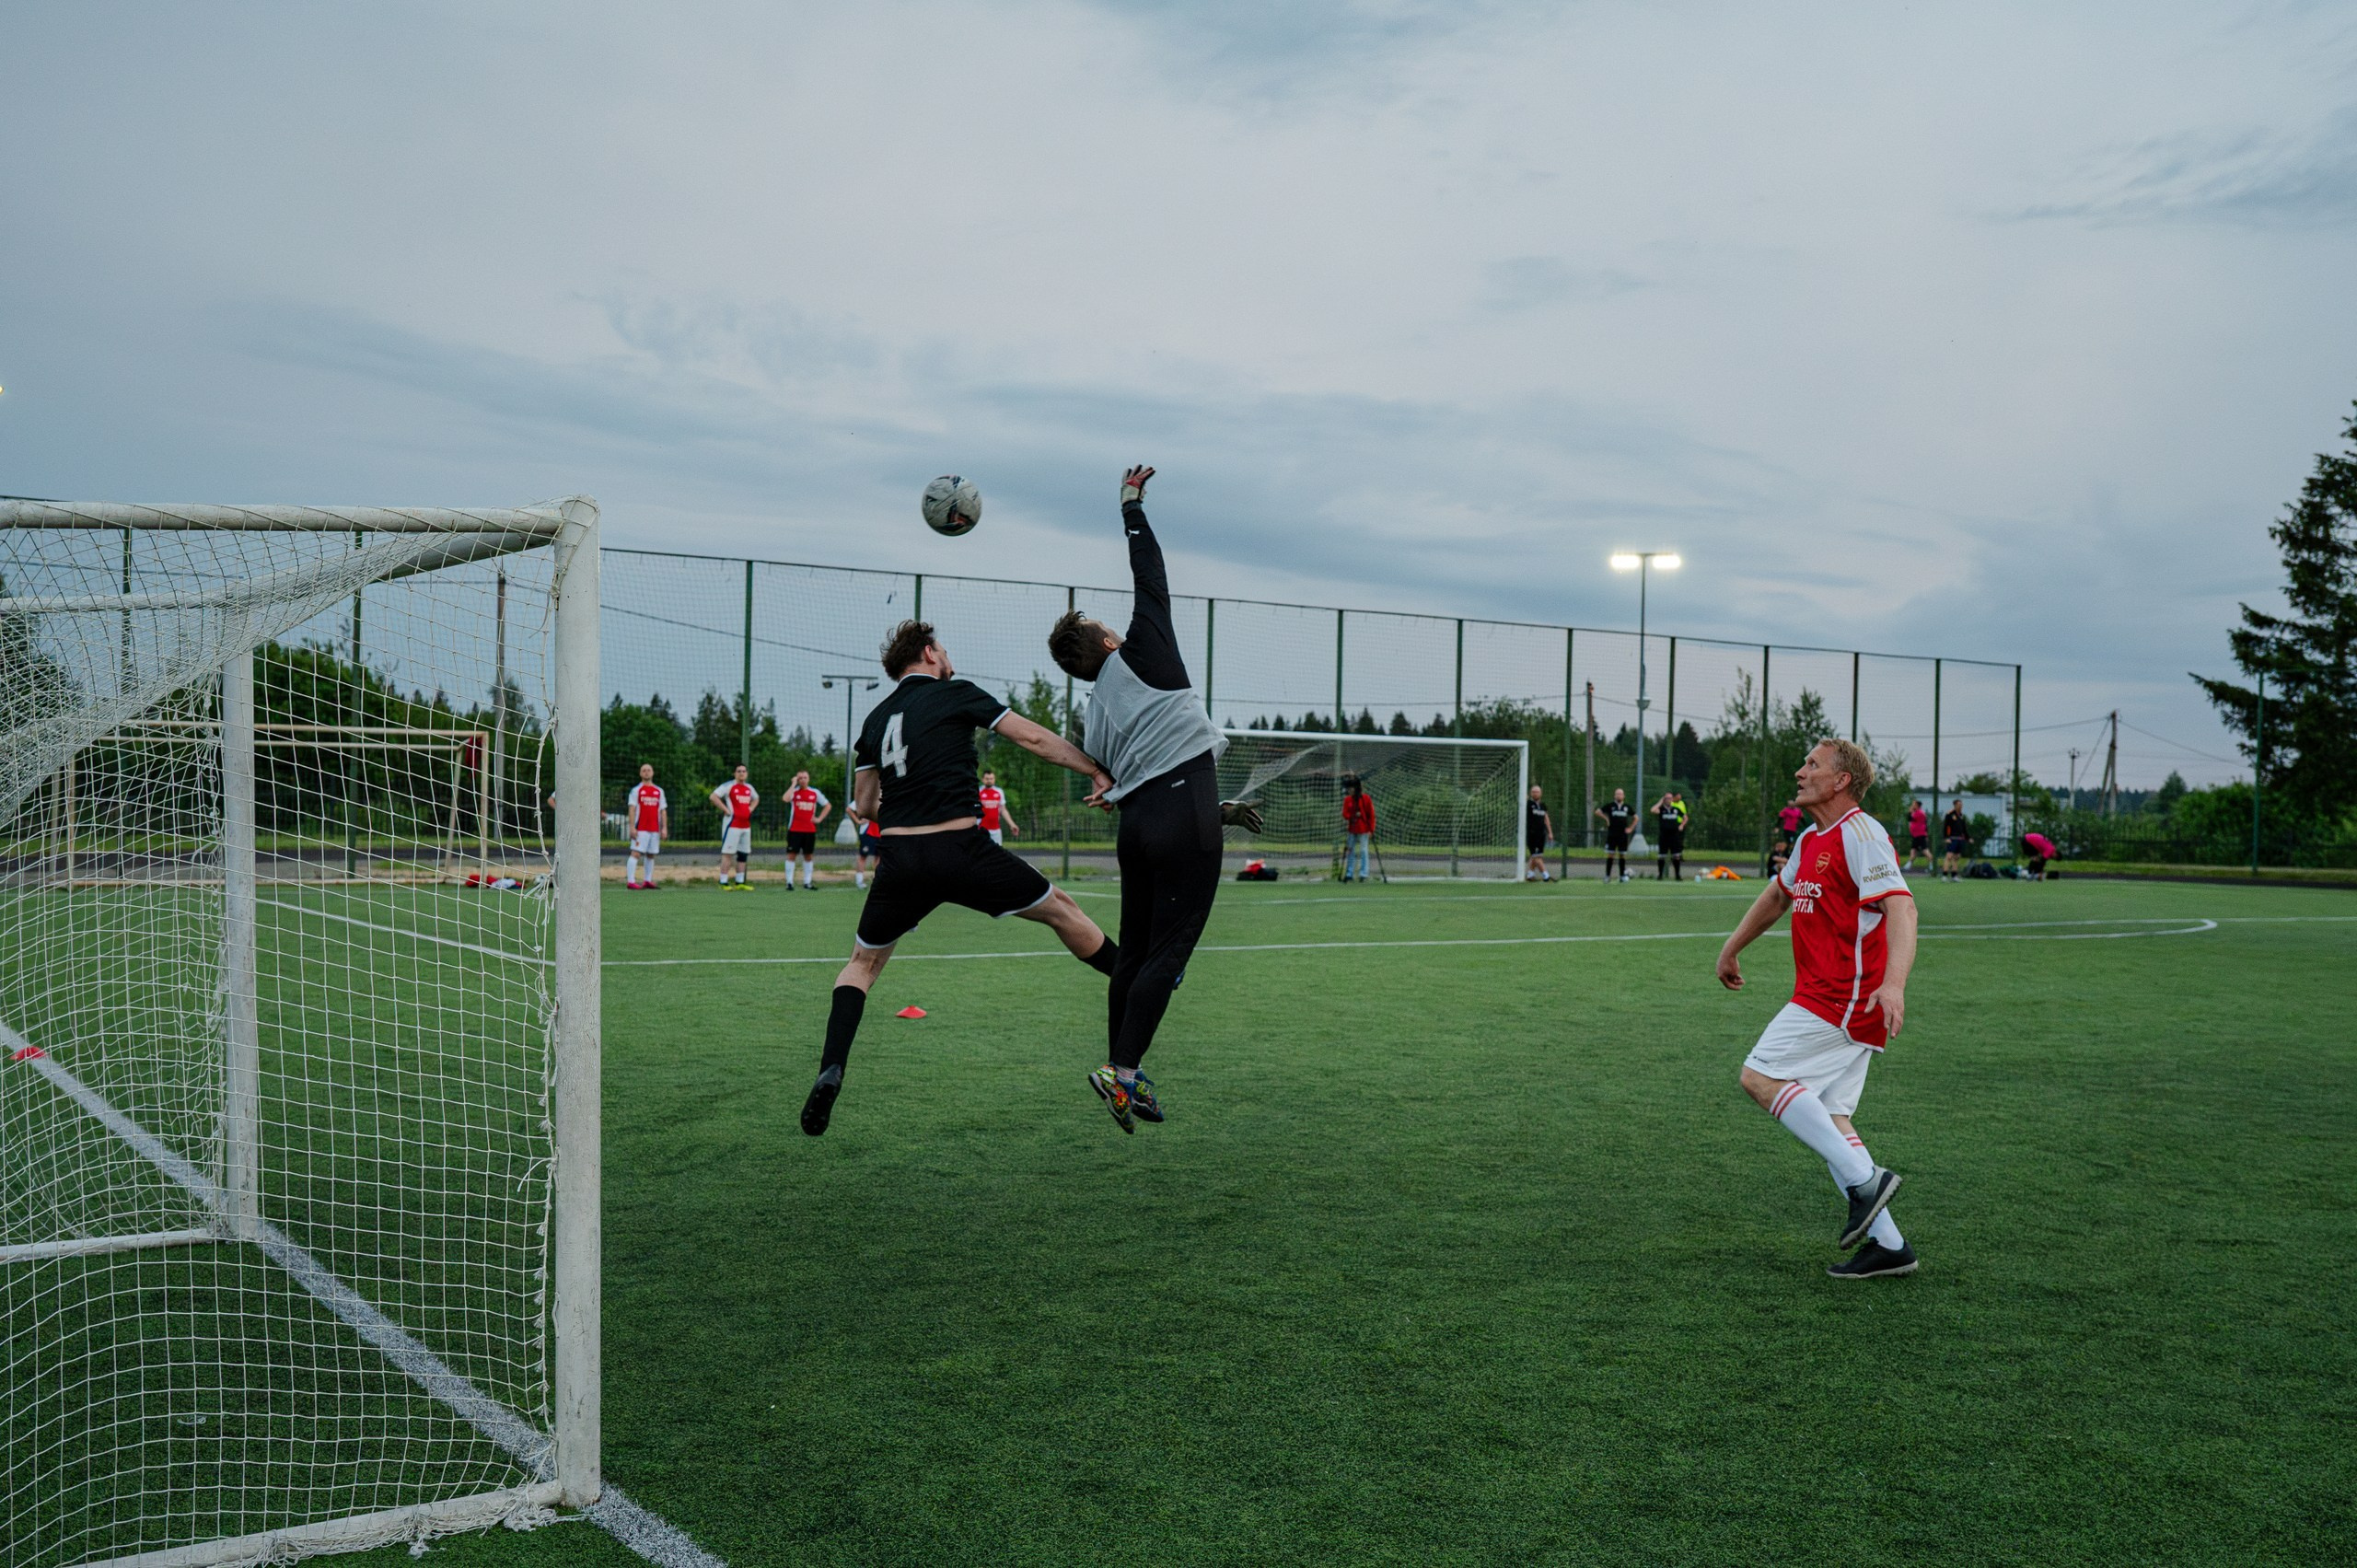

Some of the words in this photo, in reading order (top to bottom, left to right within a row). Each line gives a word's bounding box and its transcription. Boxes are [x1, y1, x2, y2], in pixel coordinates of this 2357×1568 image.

[881, 712, 909, 778] 4
[1868, 864, 1887, 874] VISIT
[1863, 870, 1898, 883] RWANDA
